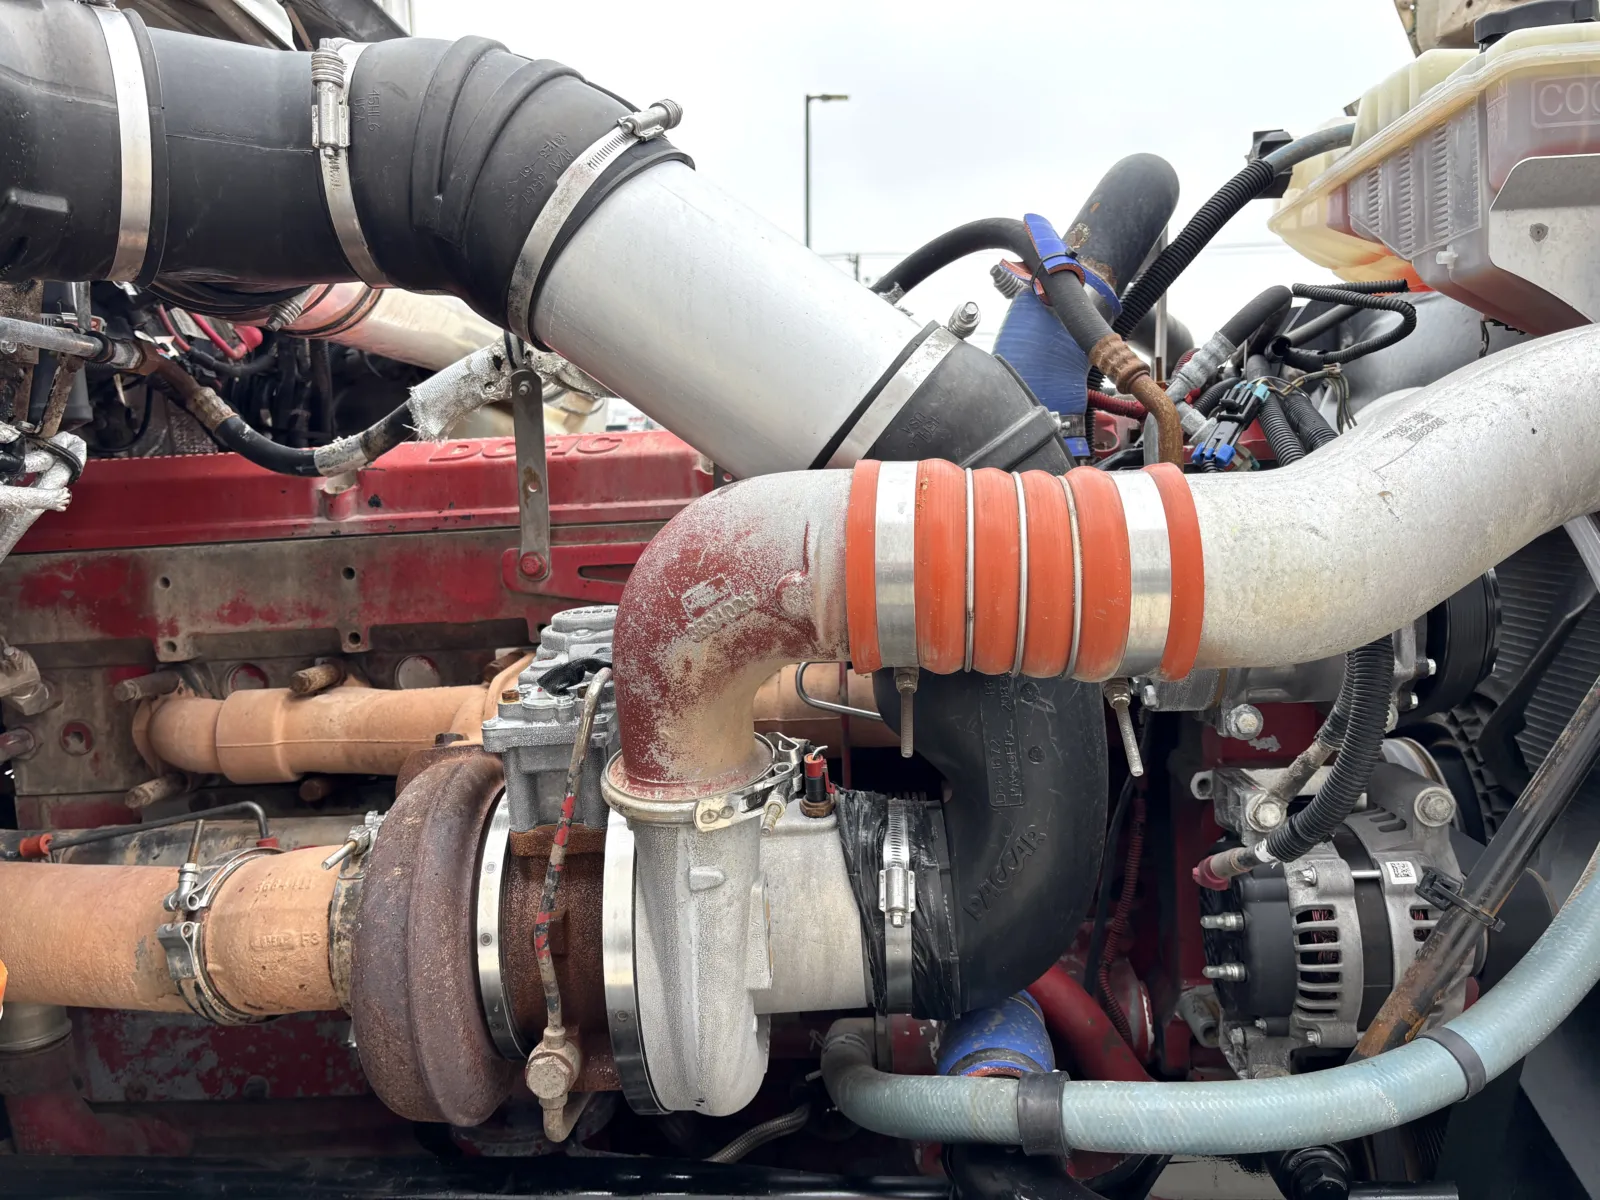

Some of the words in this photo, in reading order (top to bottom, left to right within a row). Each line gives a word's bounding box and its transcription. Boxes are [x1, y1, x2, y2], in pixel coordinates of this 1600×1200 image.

[352, 96, 366, 124] USA
[900, 411, 926, 435] USA
[962, 824, 1048, 923] PACCAR
